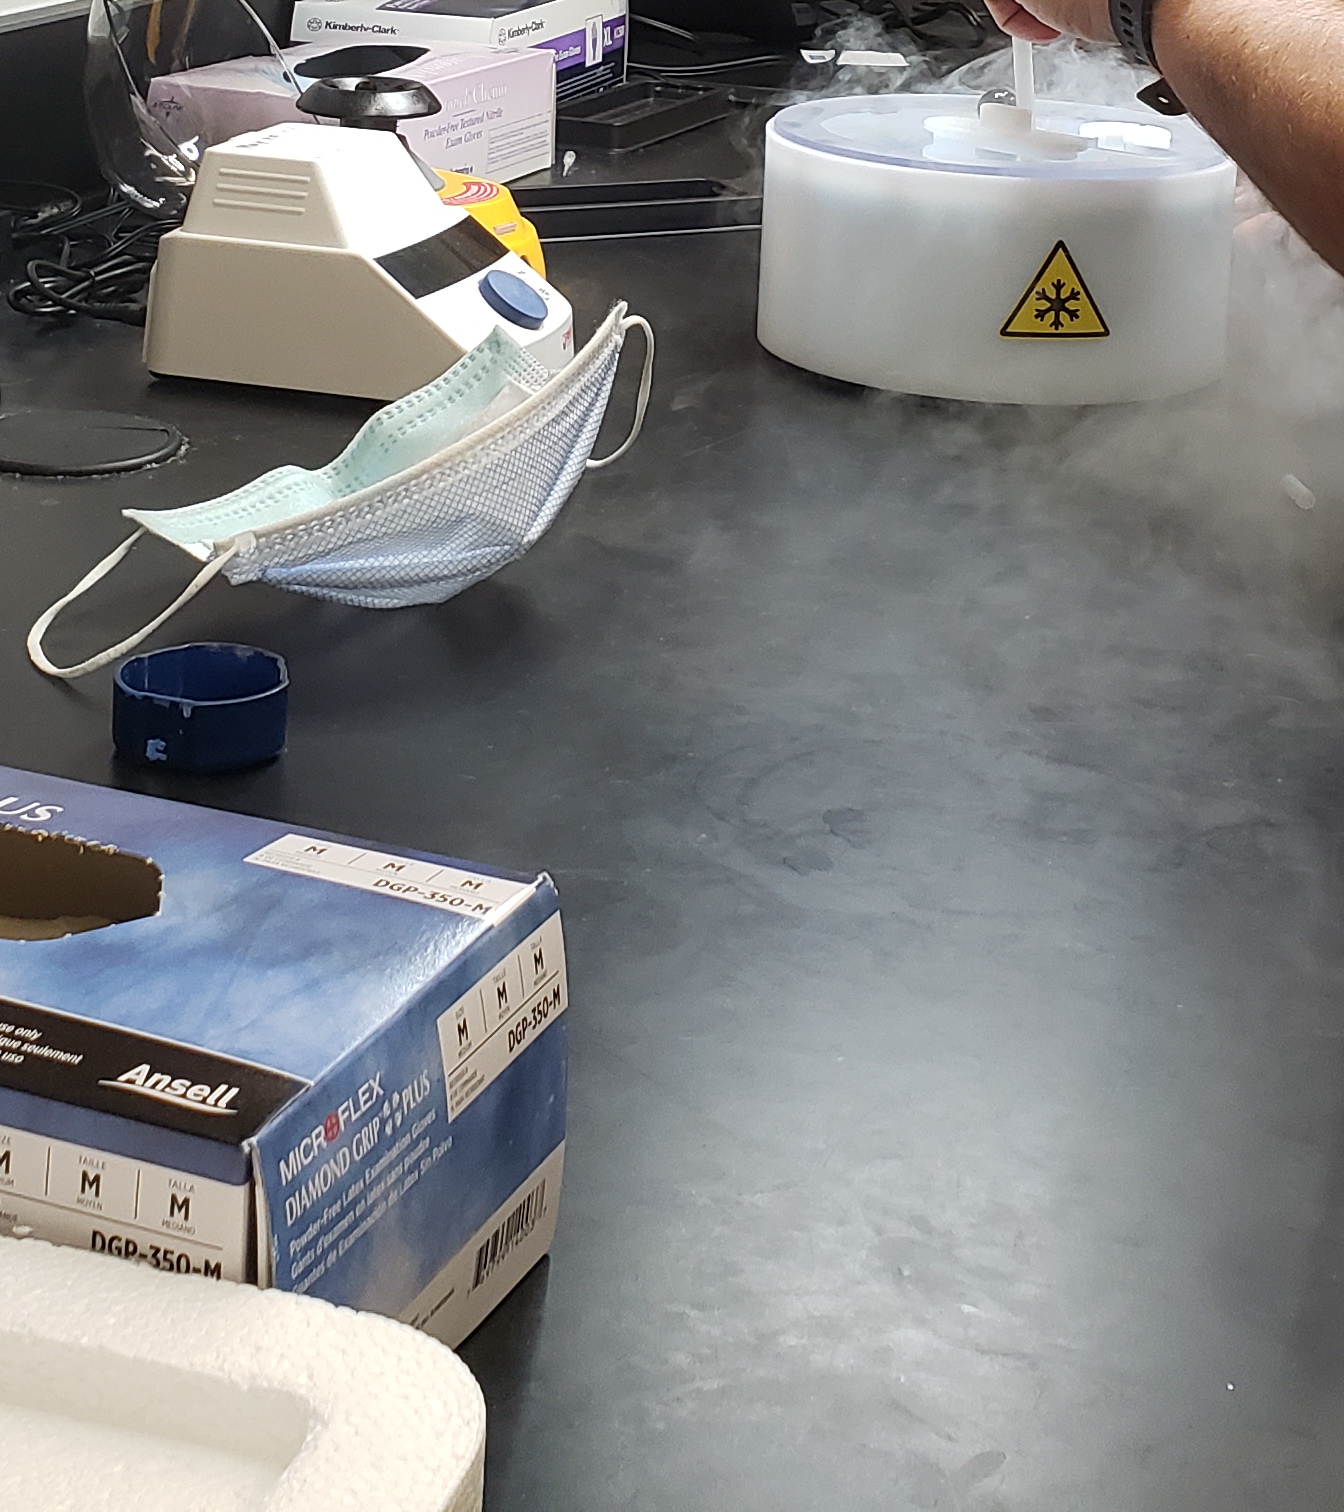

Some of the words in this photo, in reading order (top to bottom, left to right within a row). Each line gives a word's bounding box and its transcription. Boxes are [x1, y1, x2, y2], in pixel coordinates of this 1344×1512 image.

[324, 20, 398, 36] Kimberly-Clark
[445, 134, 463, 149] Exam
[304, 845, 328, 856] M
[383, 861, 406, 873] M
[372, 878, 493, 916] DGP-350-M
[460, 879, 484, 891] M
[533, 947, 545, 975] M
[497, 981, 508, 1010] M
[15, 1025, 42, 1041] only
[457, 1017, 468, 1047] M
[508, 983, 561, 1054] DGP-350-M
[2, 1051, 25, 1064] uso
[21, 1039, 84, 1065] seulement
[116, 1063, 240, 1109] Ansell
[285, 1146, 350, 1227] DIAMOND
[401, 1069, 431, 1117] PLUS
[80, 1169, 101, 1198] M
[168, 1178, 195, 1193] TALLA
[289, 1198, 342, 1258] Powder-Free
[342, 1177, 364, 1208] Latex
[365, 1132, 411, 1186] Examination
[411, 1107, 436, 1140] Gloves
[169, 1192, 190, 1221] M
[91, 1229, 222, 1281] DGP-350-M
[291, 1247, 315, 1280] Gants
[316, 1209, 354, 1256] d'examen
